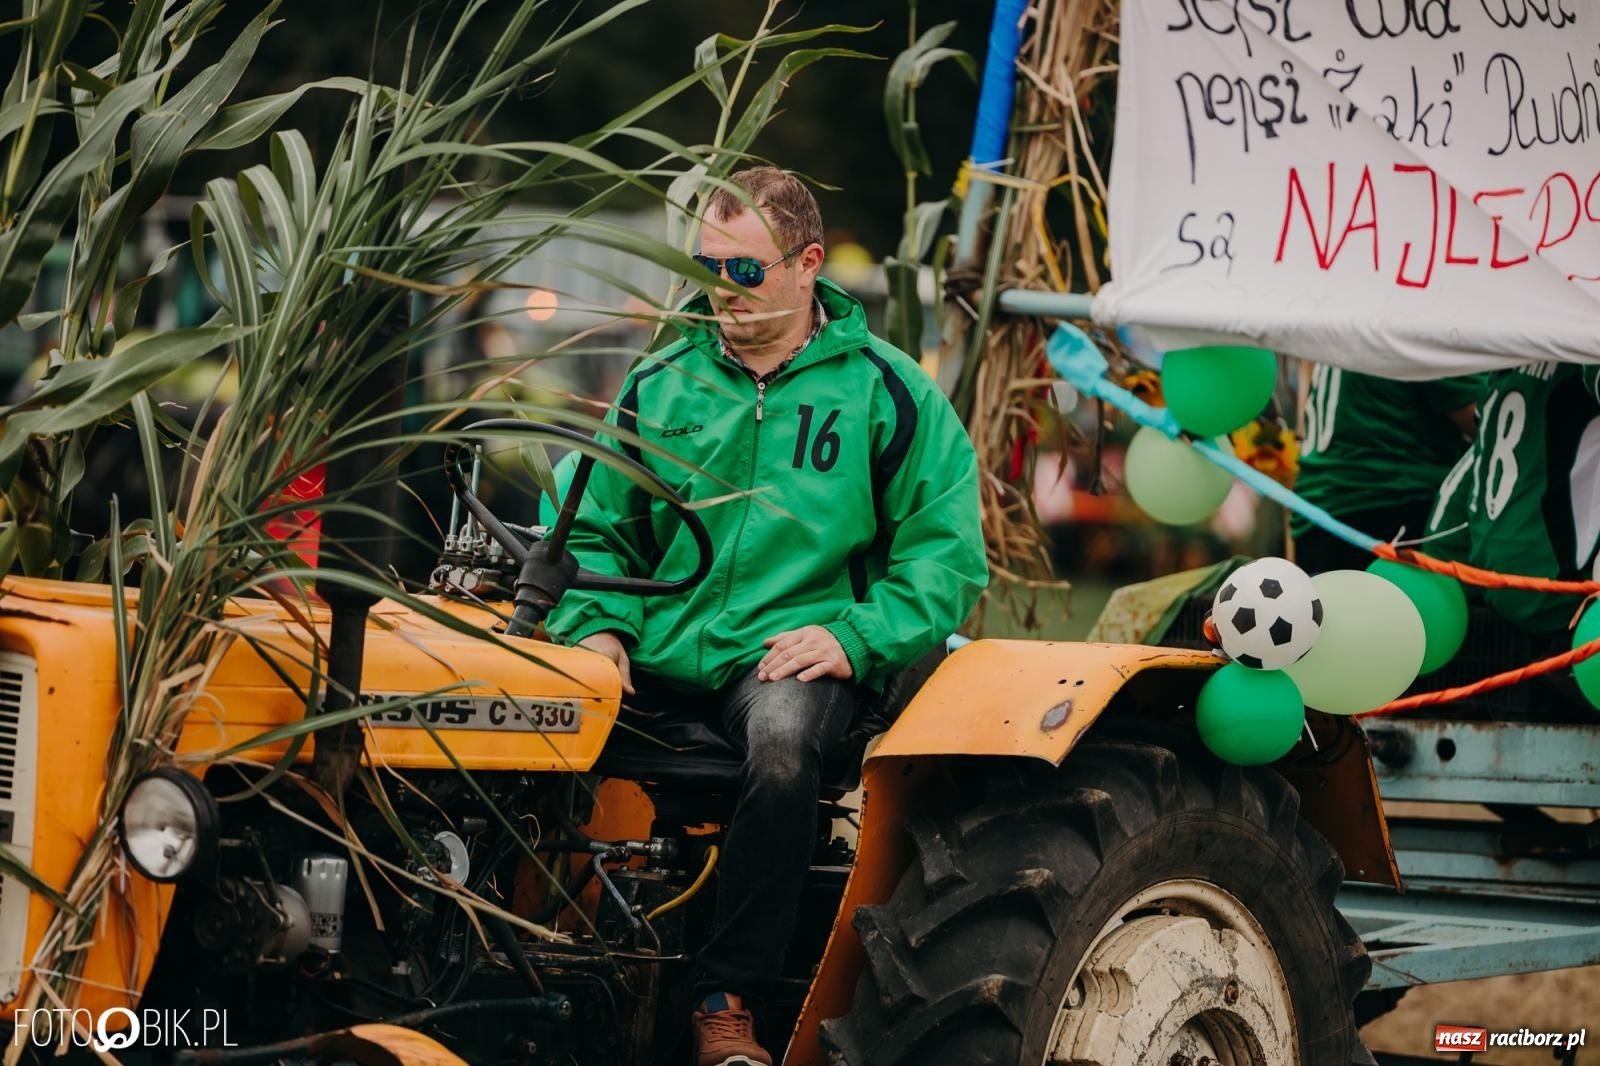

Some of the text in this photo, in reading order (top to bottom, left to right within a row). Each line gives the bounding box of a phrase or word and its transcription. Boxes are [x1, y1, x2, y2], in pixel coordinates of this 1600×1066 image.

[1175, 60, 1309, 184] pepsi
[1485, 43, 1600, 155] Rudn
[661, 424, 704, 438] COLO
[792, 404, 842, 473] 16
